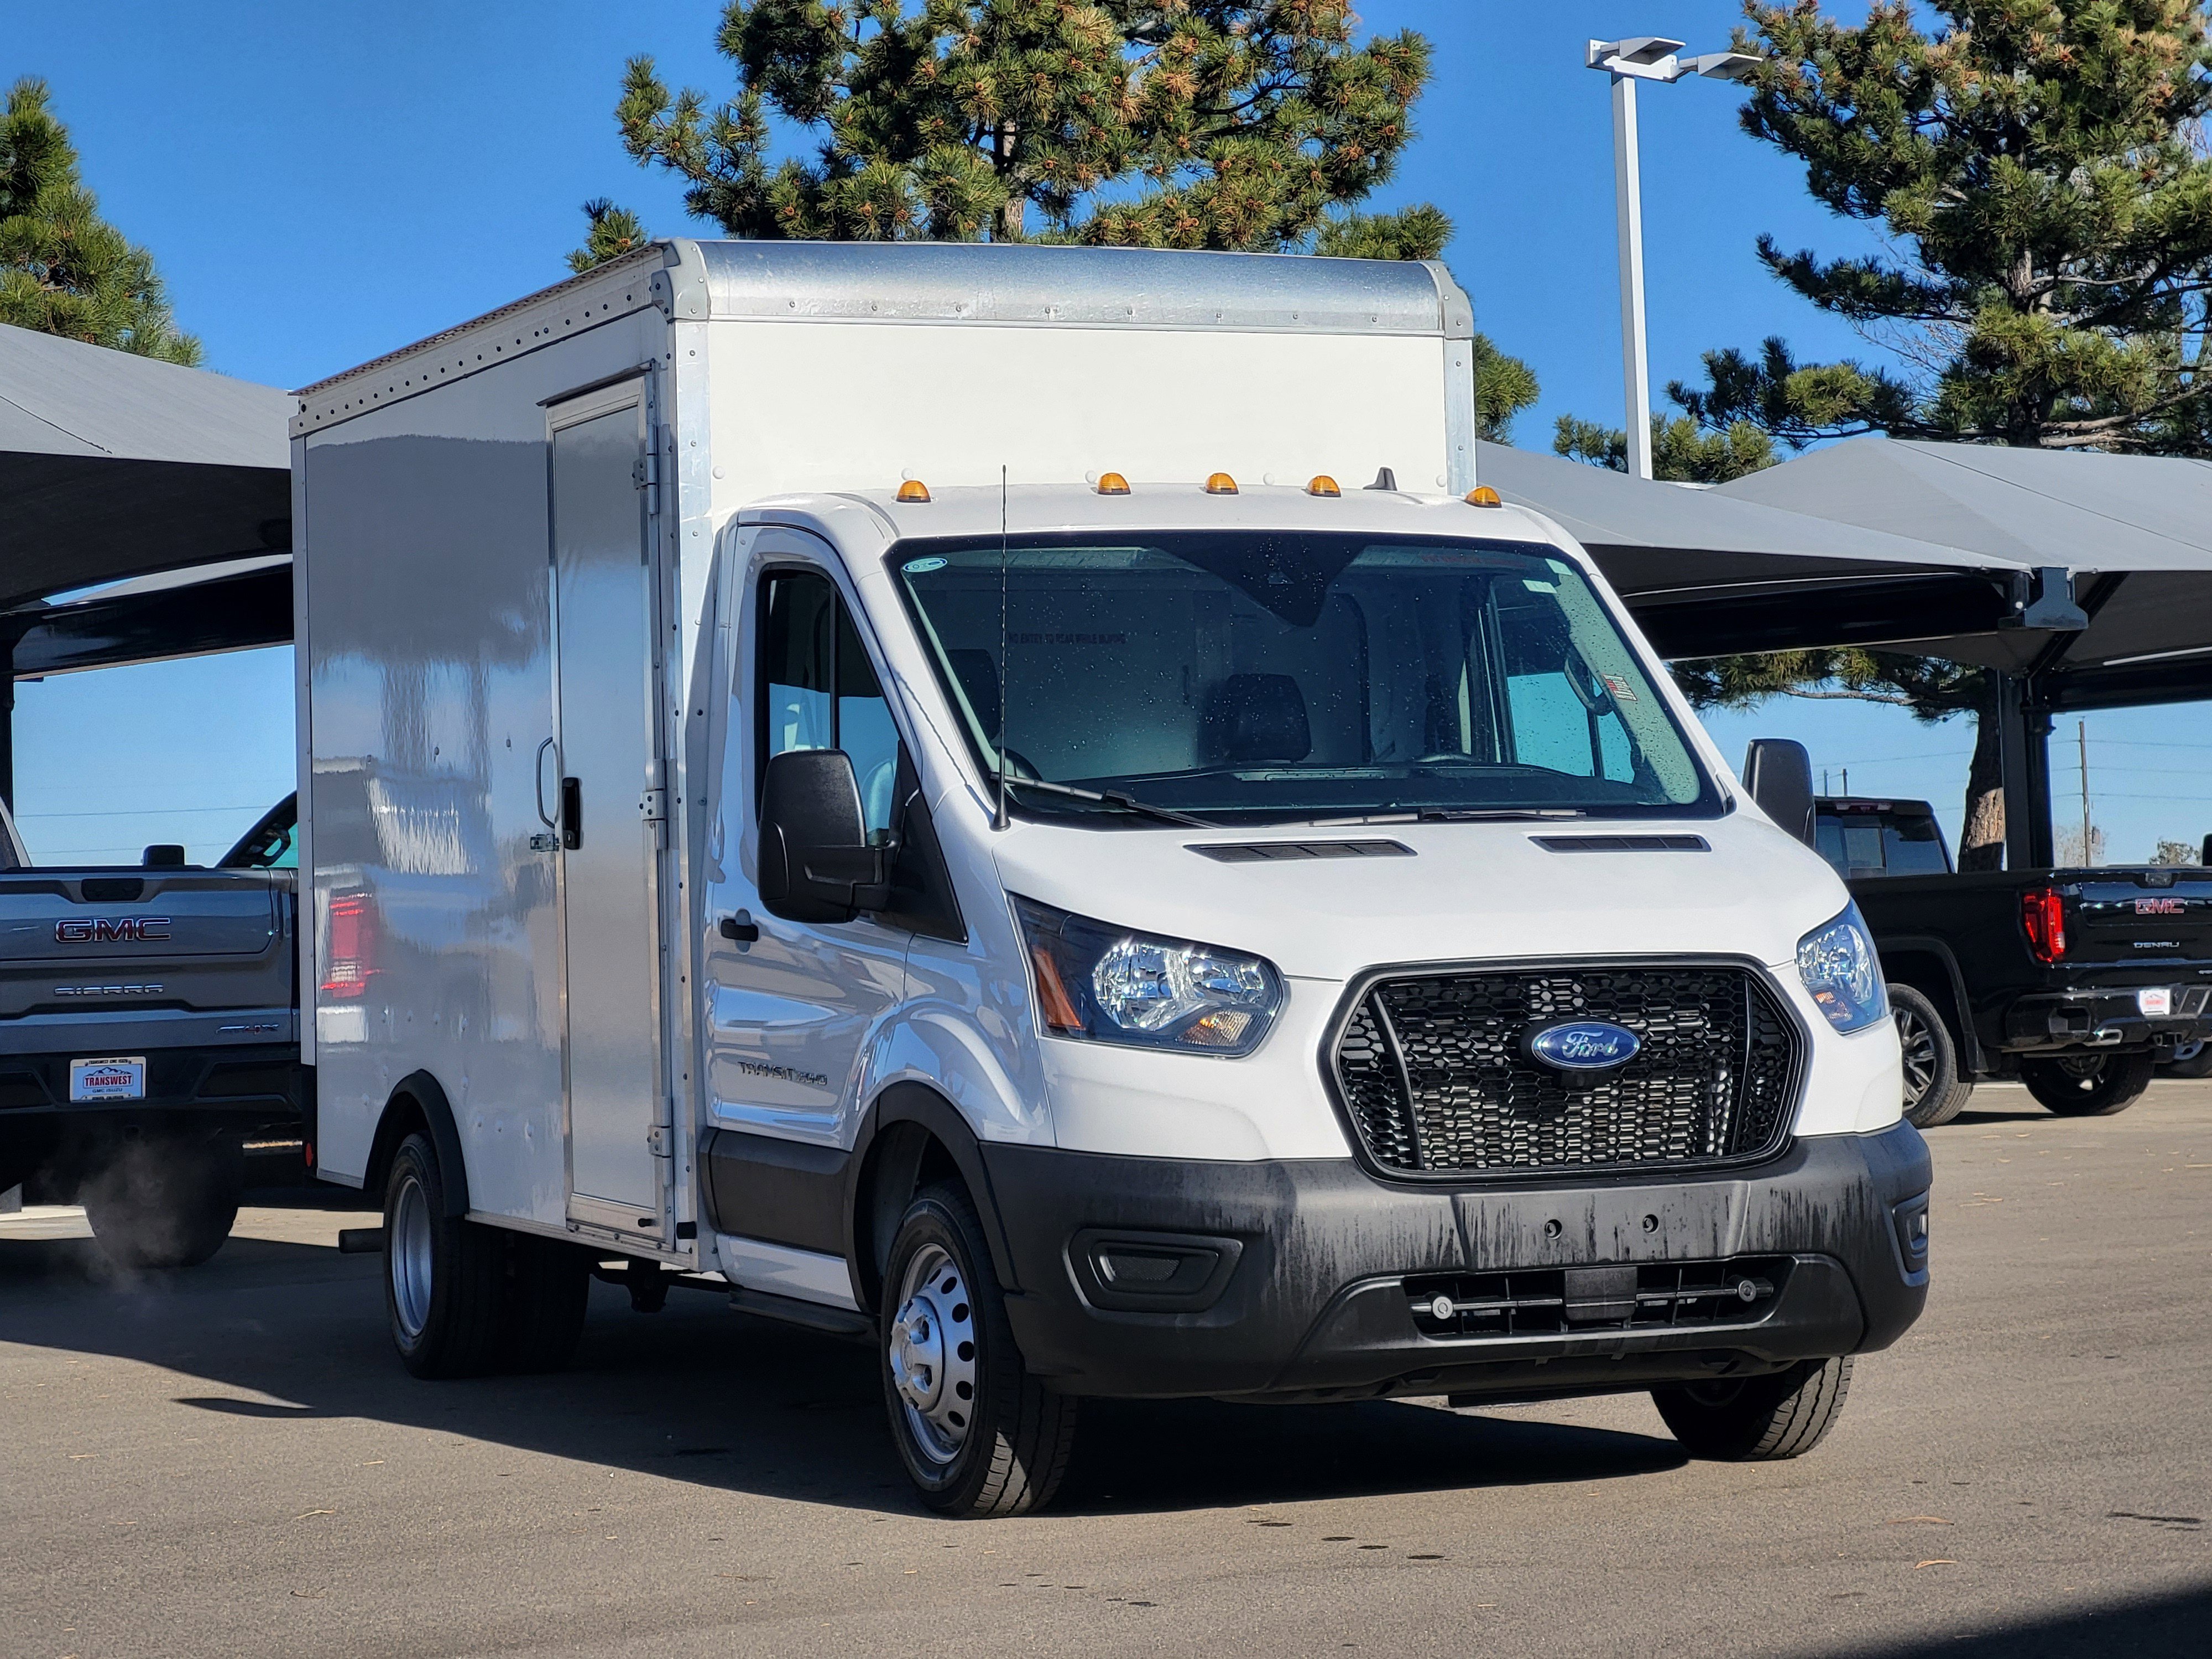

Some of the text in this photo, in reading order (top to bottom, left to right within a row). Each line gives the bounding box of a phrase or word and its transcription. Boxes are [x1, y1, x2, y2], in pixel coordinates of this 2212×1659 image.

[2135, 898, 2185, 914] GMC
[56, 917, 171, 942] GMC
[55, 984, 164, 995] SIERRA
[1562, 1031, 1619, 1058] Ford
[737, 1061, 794, 1081] TRANSIT
[85, 1075, 132, 1087] TRANSWEST
